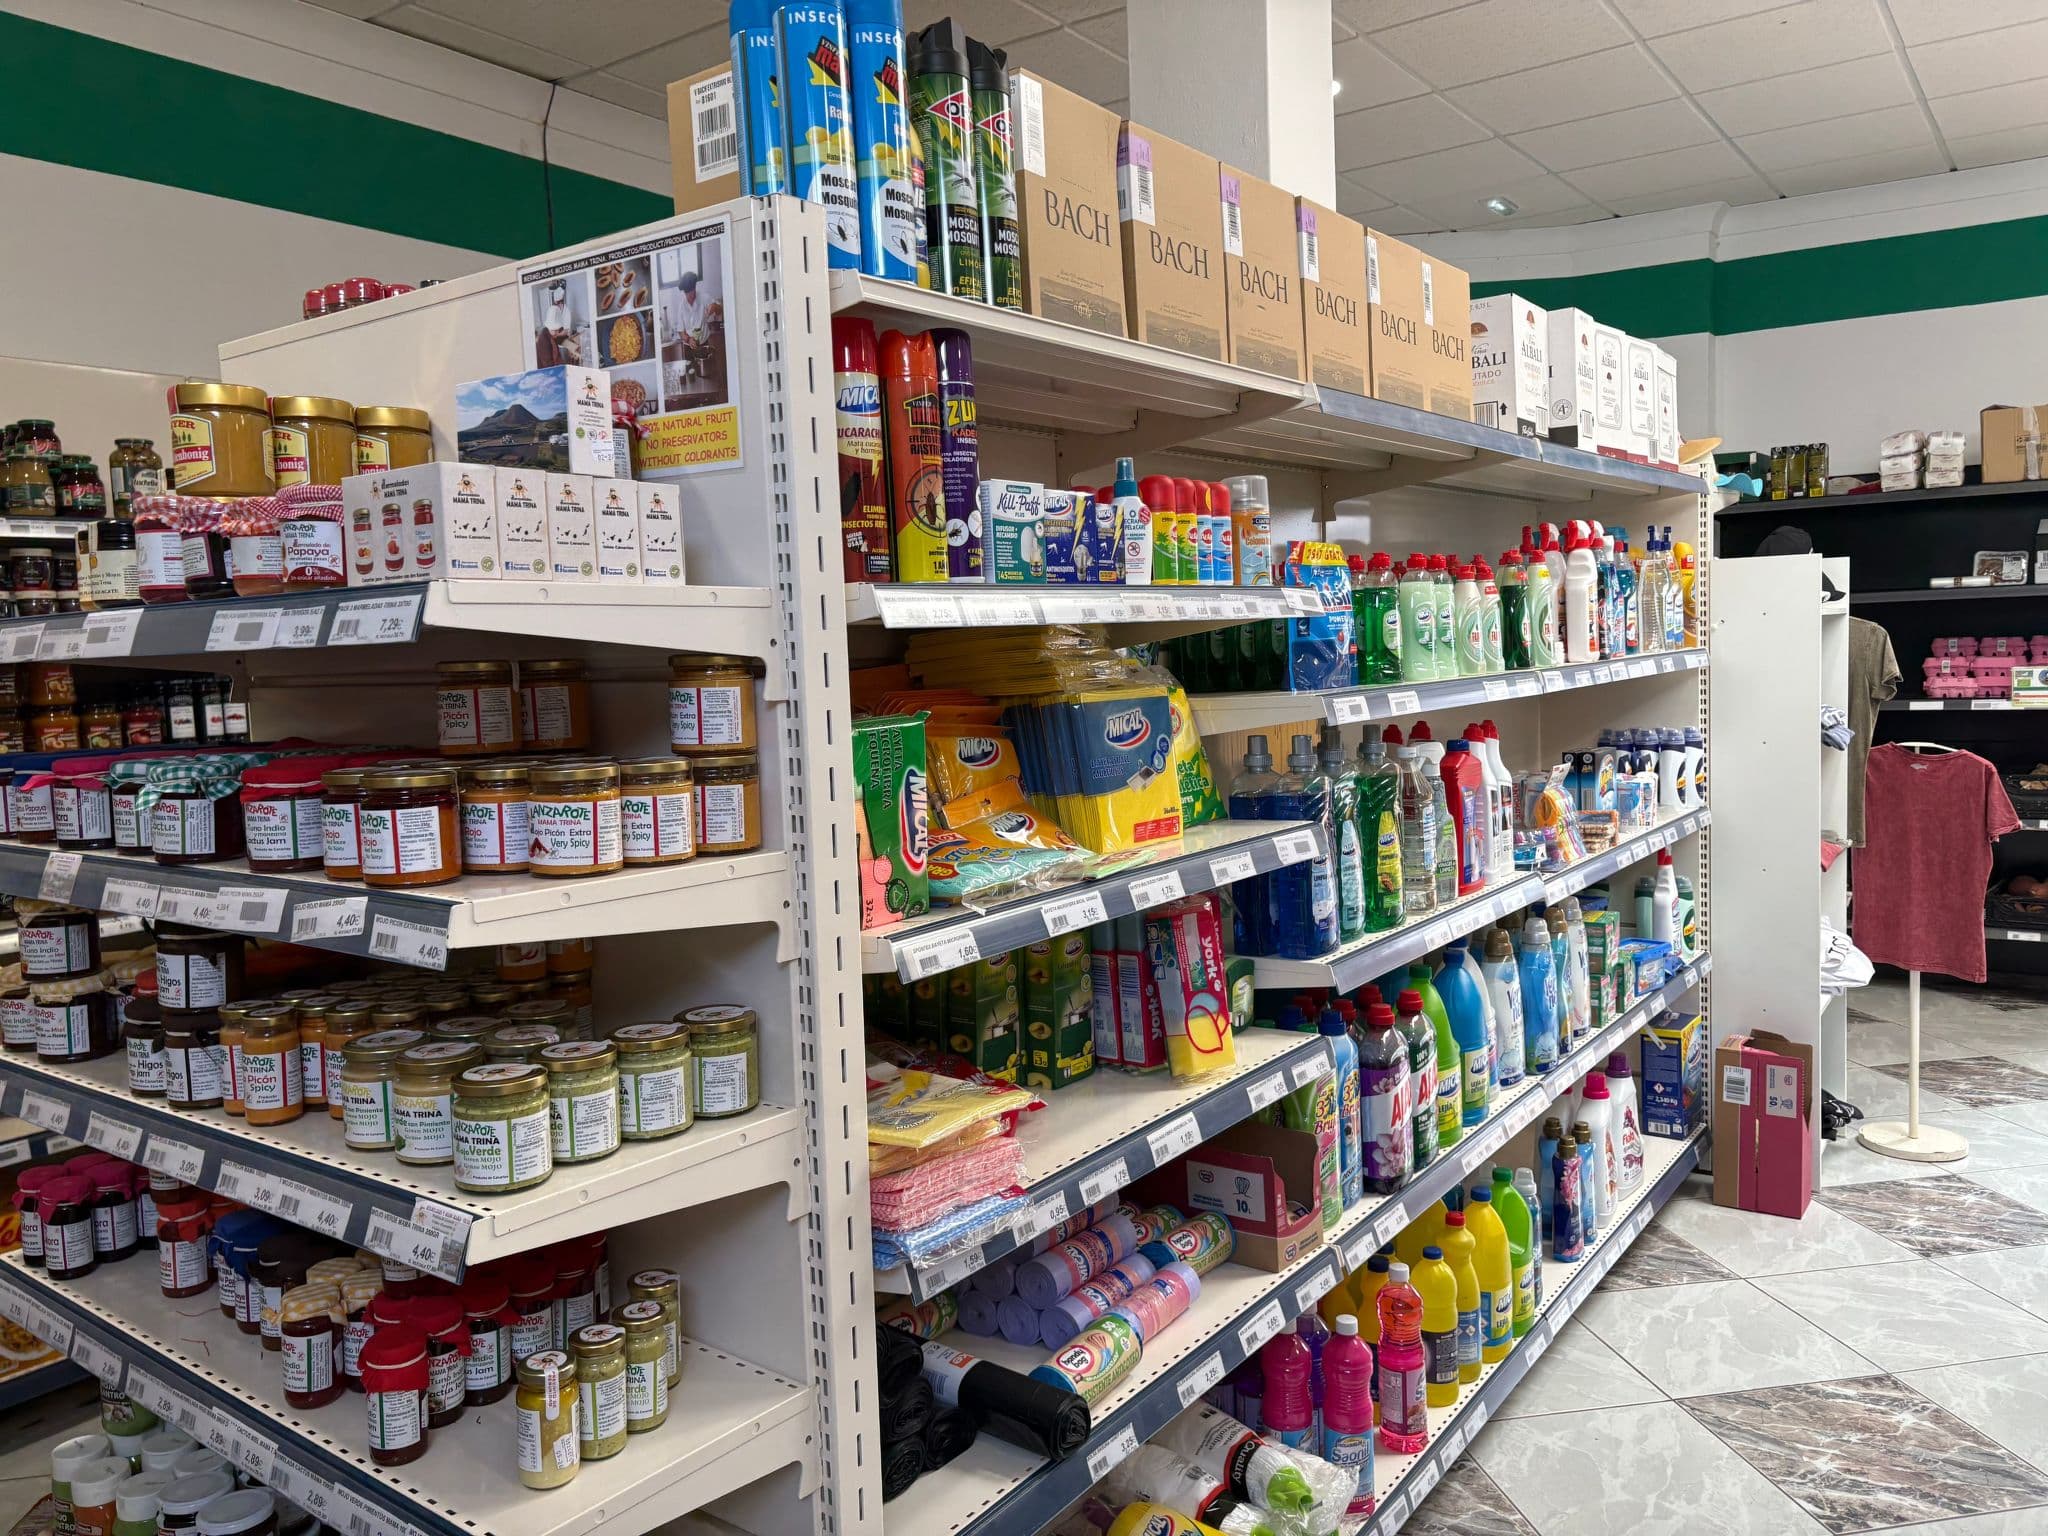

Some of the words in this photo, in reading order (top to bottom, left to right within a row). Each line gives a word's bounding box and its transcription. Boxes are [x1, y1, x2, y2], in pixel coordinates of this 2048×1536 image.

[1044, 188, 1112, 247] BACH
[1149, 230, 1210, 279] BACH
[1239, 261, 1289, 304] BACH
[1315, 287, 1357, 327] BACH
[1380, 310, 1417, 345] BACH
[1431, 329, 1464, 361] BACH
[663, 416, 702, 431] NATURAL
[706, 411, 733, 425] FRUIT
[646, 440, 659, 451] NO
[662, 430, 728, 448] PRESERVATORS
[639, 453, 681, 469] WITHOUT
[685, 446, 737, 463] COLORANTS
[996, 492, 1041, 516] Kill-Paff
[288, 546, 329, 557] Papaya
[680, 712, 696, 720] Extra
[446, 720, 468, 729] Spicy
[680, 720, 695, 731] Spicy
[1108, 709, 1143, 739] MICAL
[959, 737, 994, 758] MICAL
[529, 803, 591, 821] LANZAROTE
[908, 775, 927, 857] MICAL
[559, 818, 582, 826] TRINA
[631, 823, 652, 831] Extra
[263, 824, 286, 832] Indio
[465, 827, 482, 838] Rojo
[544, 827, 566, 837] Picón
[569, 828, 592, 836] Extra
[326, 830, 340, 839] Rojo
[633, 831, 650, 842] Spicy
[266, 837, 286, 845] Jam
[363, 837, 378, 848] Rojo
[551, 838, 568, 850] Very
[570, 838, 590, 850] Spicy
[1201, 936, 1216, 982] york
[160, 977, 181, 988] Higos
[138, 1060, 163, 1070] Higos
[247, 1075, 277, 1084] Picón
[250, 1084, 276, 1093] Spicy
[351, 1097, 376, 1105] TRINA
[413, 1109, 443, 1118] TRINA
[471, 1137, 500, 1145] TRINA
[469, 1145, 501, 1156] Verde
[480, 1156, 501, 1164] MOJO
[480, 1164, 502, 1172] MOJO
[1181, 1238, 1194, 1249] bag
[1062, 1348, 1084, 1365] handy
[1074, 1354, 1090, 1369] bag
[475, 1366, 494, 1376] Jam
[1232, 1440, 1255, 1486] Quality
